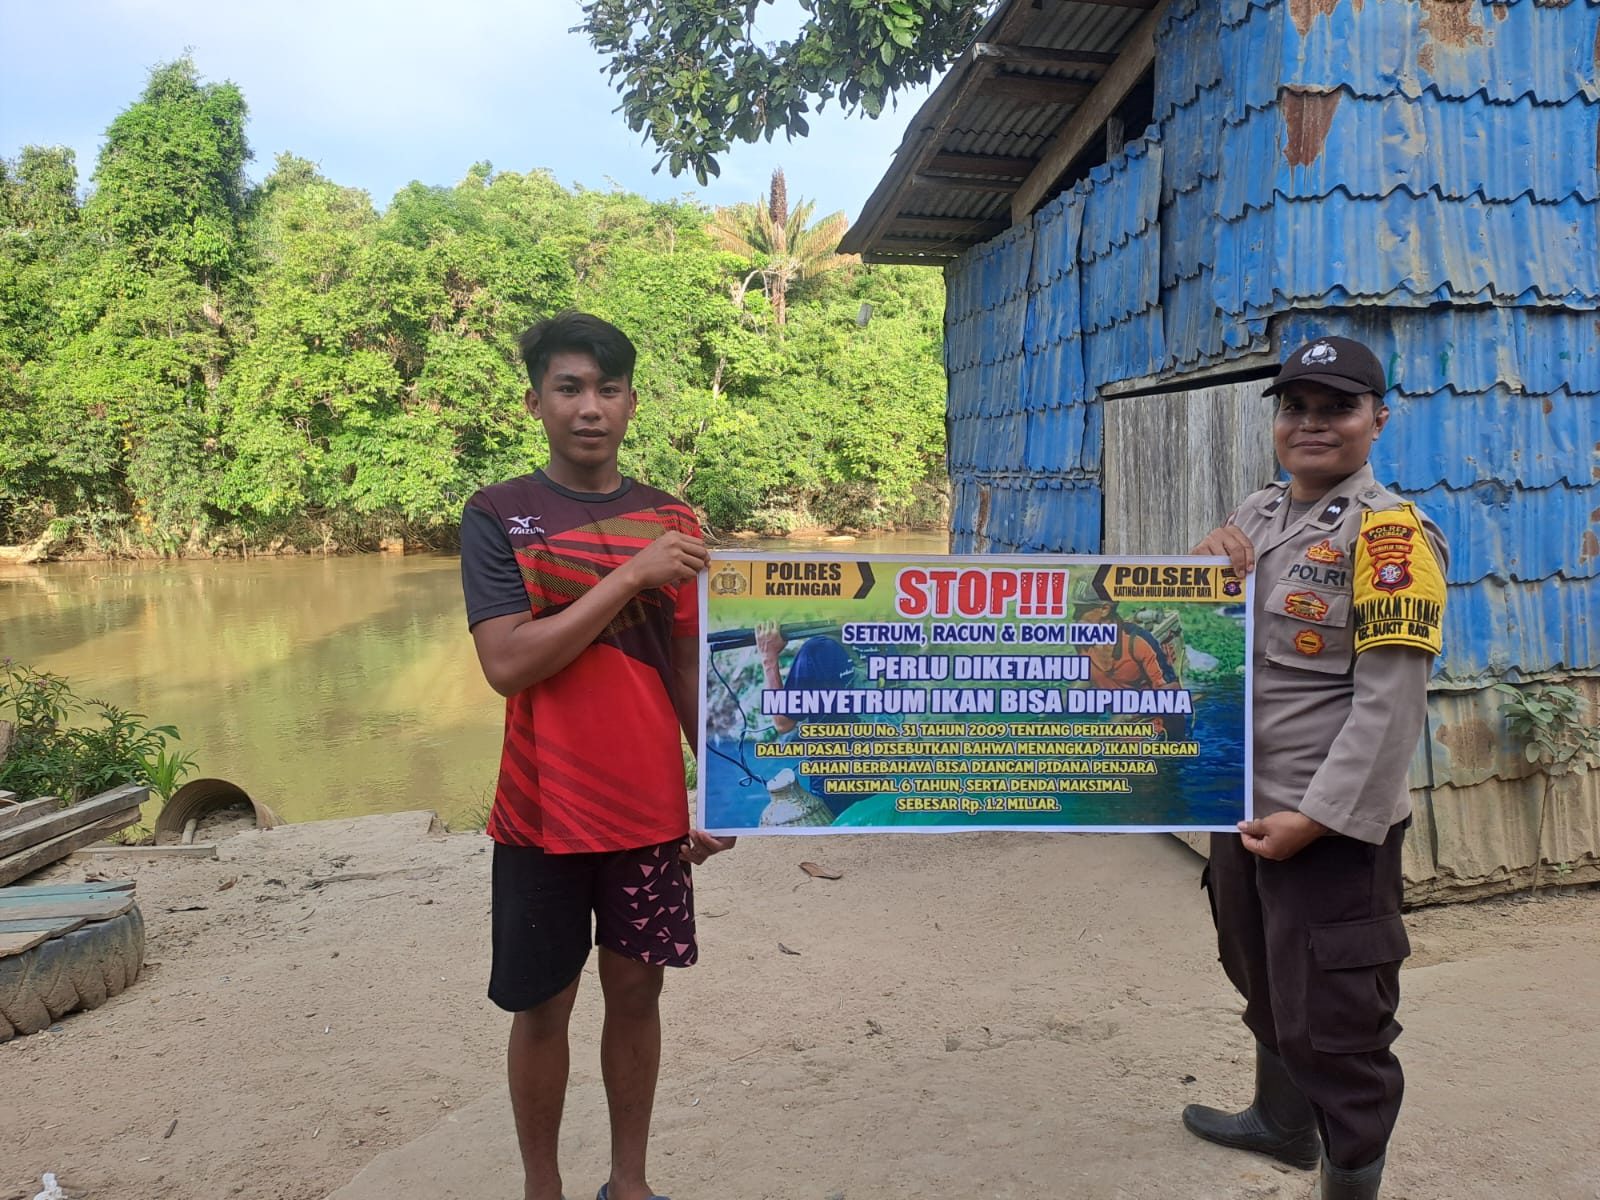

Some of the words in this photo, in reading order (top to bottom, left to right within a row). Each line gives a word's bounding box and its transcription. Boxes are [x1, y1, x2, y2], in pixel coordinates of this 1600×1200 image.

[766, 562, 842, 581] POLRES
[1115, 566, 1211, 586] POLSEK
[1288, 564, 1347, 587] POLRI
[765, 582, 842, 596] KATINGAN
[899, 569, 1066, 615] STOP!!!
[1113, 586, 1145, 597] KATINGAN
[1145, 586, 1162, 597] HULU
[1162, 586, 1176, 597] DAN
[1176, 587, 1196, 598] BUKIT
[1196, 587, 1212, 598] RAYA
[844, 624, 927, 645] SETRUM,
[933, 625, 995, 642] RACUN
[1001, 625, 1015, 642] &
[1021, 625, 1065, 642] BOM
[1071, 625, 1116, 643] IKAN
[1408, 622, 1430, 639] RAYA
[869, 656, 949, 680] PERLU
[955, 656, 1090, 680] DIKETAHUI
[763, 690, 926, 714] MENYETRUM
[932, 690, 994, 713] IKAN
[1000, 690, 1062, 713] BISA
[1068, 690, 1192, 713] DIPIDANA
[800, 724, 849, 737] SESUAI
[853, 724, 872, 737] UU
[876, 724, 899, 737] No.
[902, 724, 917, 737] 31
[920, 724, 965, 737] TAHUN
[969, 724, 1006, 737] 2009
[1009, 724, 1070, 737] TENTANG
[1073, 724, 1155, 738] PERIKANAN,
[757, 743, 803, 756] DALAM
[807, 743, 850, 756] PASAL
[853, 743, 871, 756] 84
[873, 743, 959, 756] DISEBUTKAN
[963, 743, 1014, 755] BAHWA
[1017, 743, 1101, 755] MENANGKAP
[1104, 743, 1139, 755] IKAN
[1142, 743, 1198, 755] DENGAN
[801, 761, 849, 774] BAHAN
[853, 761, 932, 774] BERBAHAYA
[935, 761, 968, 773] BISA
[971, 761, 1034, 773] DIANCAM
[1038, 761, 1090, 773] PIDANA
[1092, 761, 1156, 774] PENJARA
[826, 780, 898, 793] MAKSIMAL
[900, 780, 912, 792] 6
[914, 780, 963, 793] TAHUN,
[966, 780, 1007, 792] SERTA
[1010, 780, 1057, 792] DENDA
[1059, 780, 1130, 792] MAKSIMAL
[897, 798, 958, 811] SEBESAR
[961, 798, 983, 814] Rp.
[986, 798, 1006, 811] 1.2
[1007, 798, 1060, 811] MILIAR.
